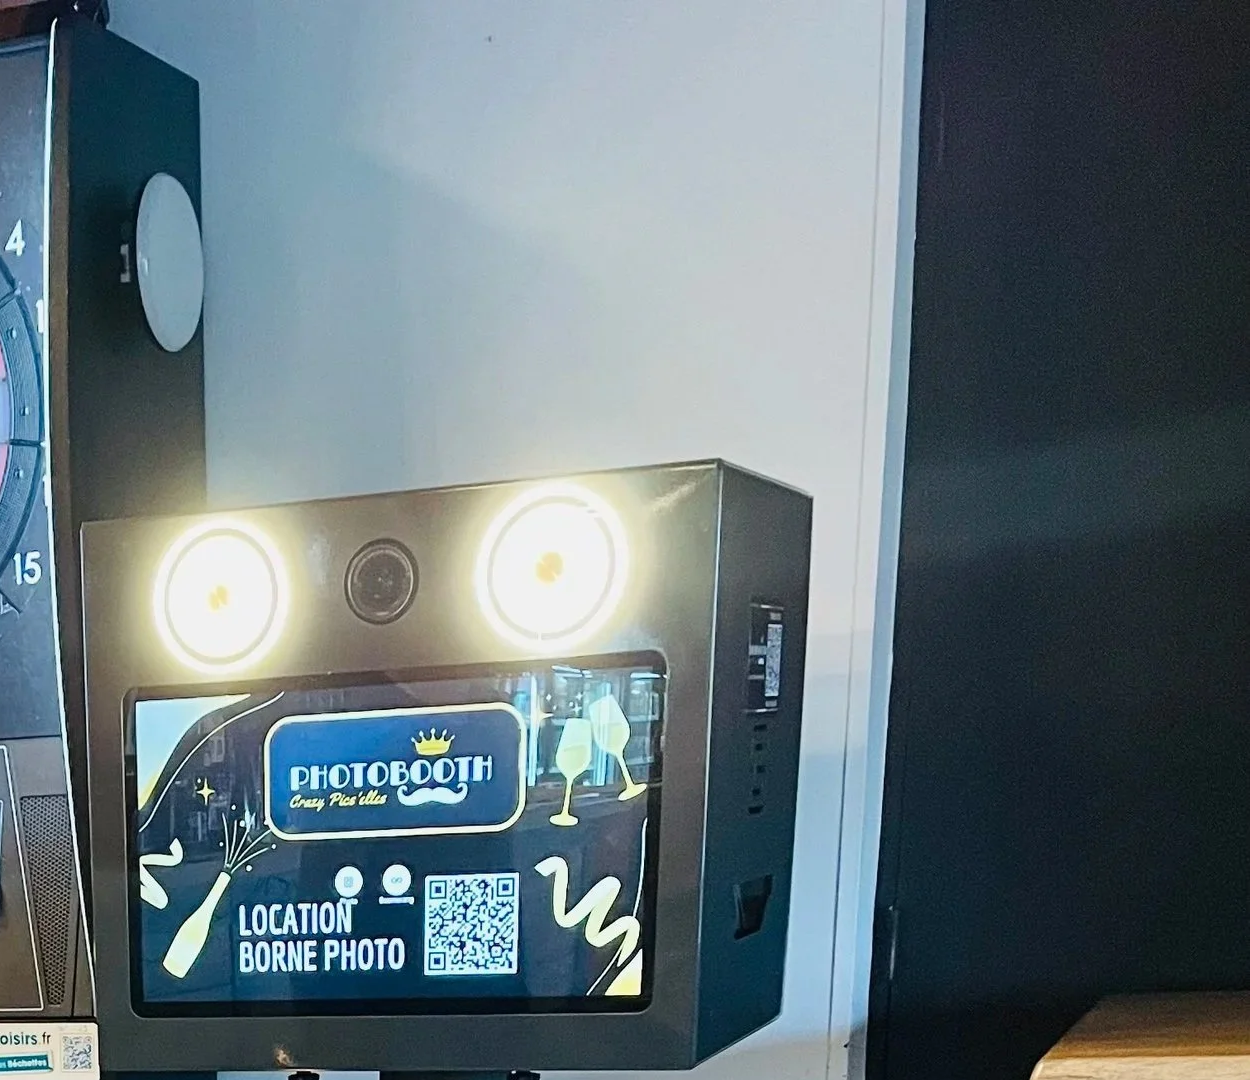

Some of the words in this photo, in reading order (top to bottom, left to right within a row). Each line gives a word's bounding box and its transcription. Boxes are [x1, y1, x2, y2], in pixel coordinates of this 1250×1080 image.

[4, 219, 26, 257] 4
[13, 551, 42, 586] 15
[290, 754, 493, 792] PHOTOBOOTH
[290, 794, 326, 812] Crazy
[238, 901, 352, 937] LOCATION
[239, 939, 318, 973] BORNE
[323, 937, 406, 971] PHOTO
